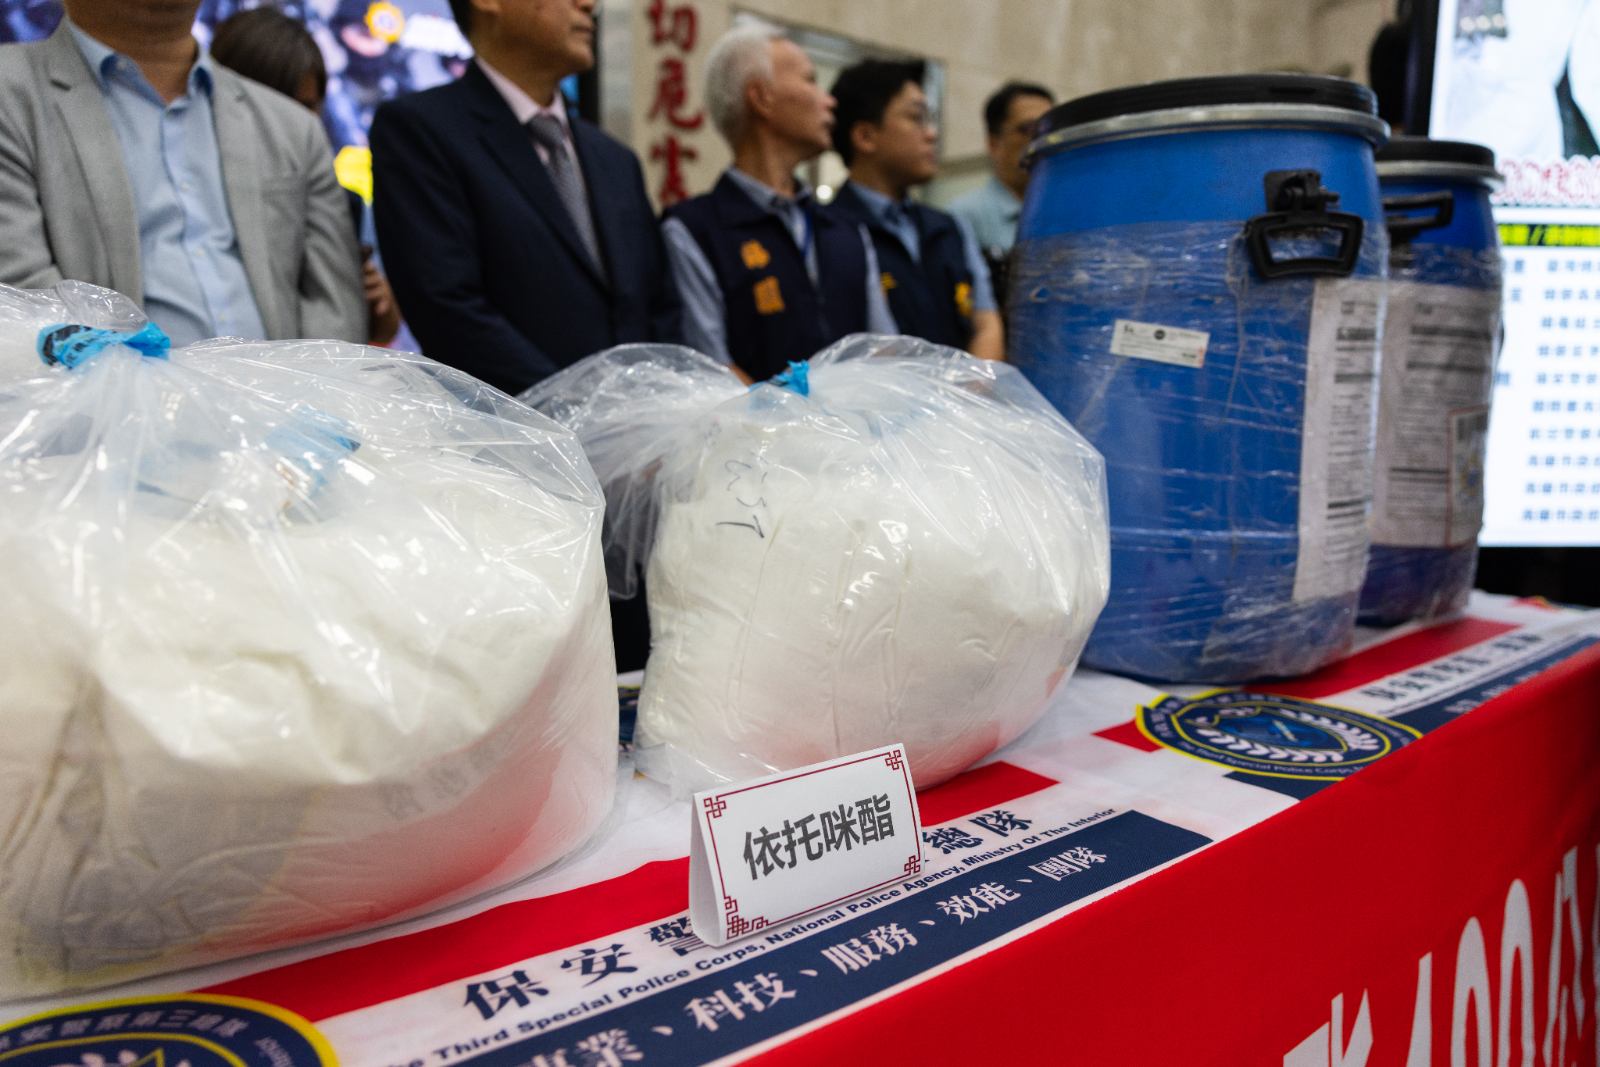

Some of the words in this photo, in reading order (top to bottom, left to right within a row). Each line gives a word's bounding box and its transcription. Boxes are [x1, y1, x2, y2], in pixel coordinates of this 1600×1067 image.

[742, 793, 895, 881] 依托咪酯
[432, 1029, 509, 1059] Third
[517, 994, 613, 1032] Special
[618, 968, 691, 999] Police
[695, 943, 767, 972] Corps,
[766, 909, 846, 945] National
[849, 888, 902, 914] Police
[903, 865, 966, 892] Agency,
[963, 842, 1022, 867] Ministry
[1022, 834, 1041, 845] Of
[1042, 825, 1068, 838] The
[1070, 807, 1117, 828] Interior
